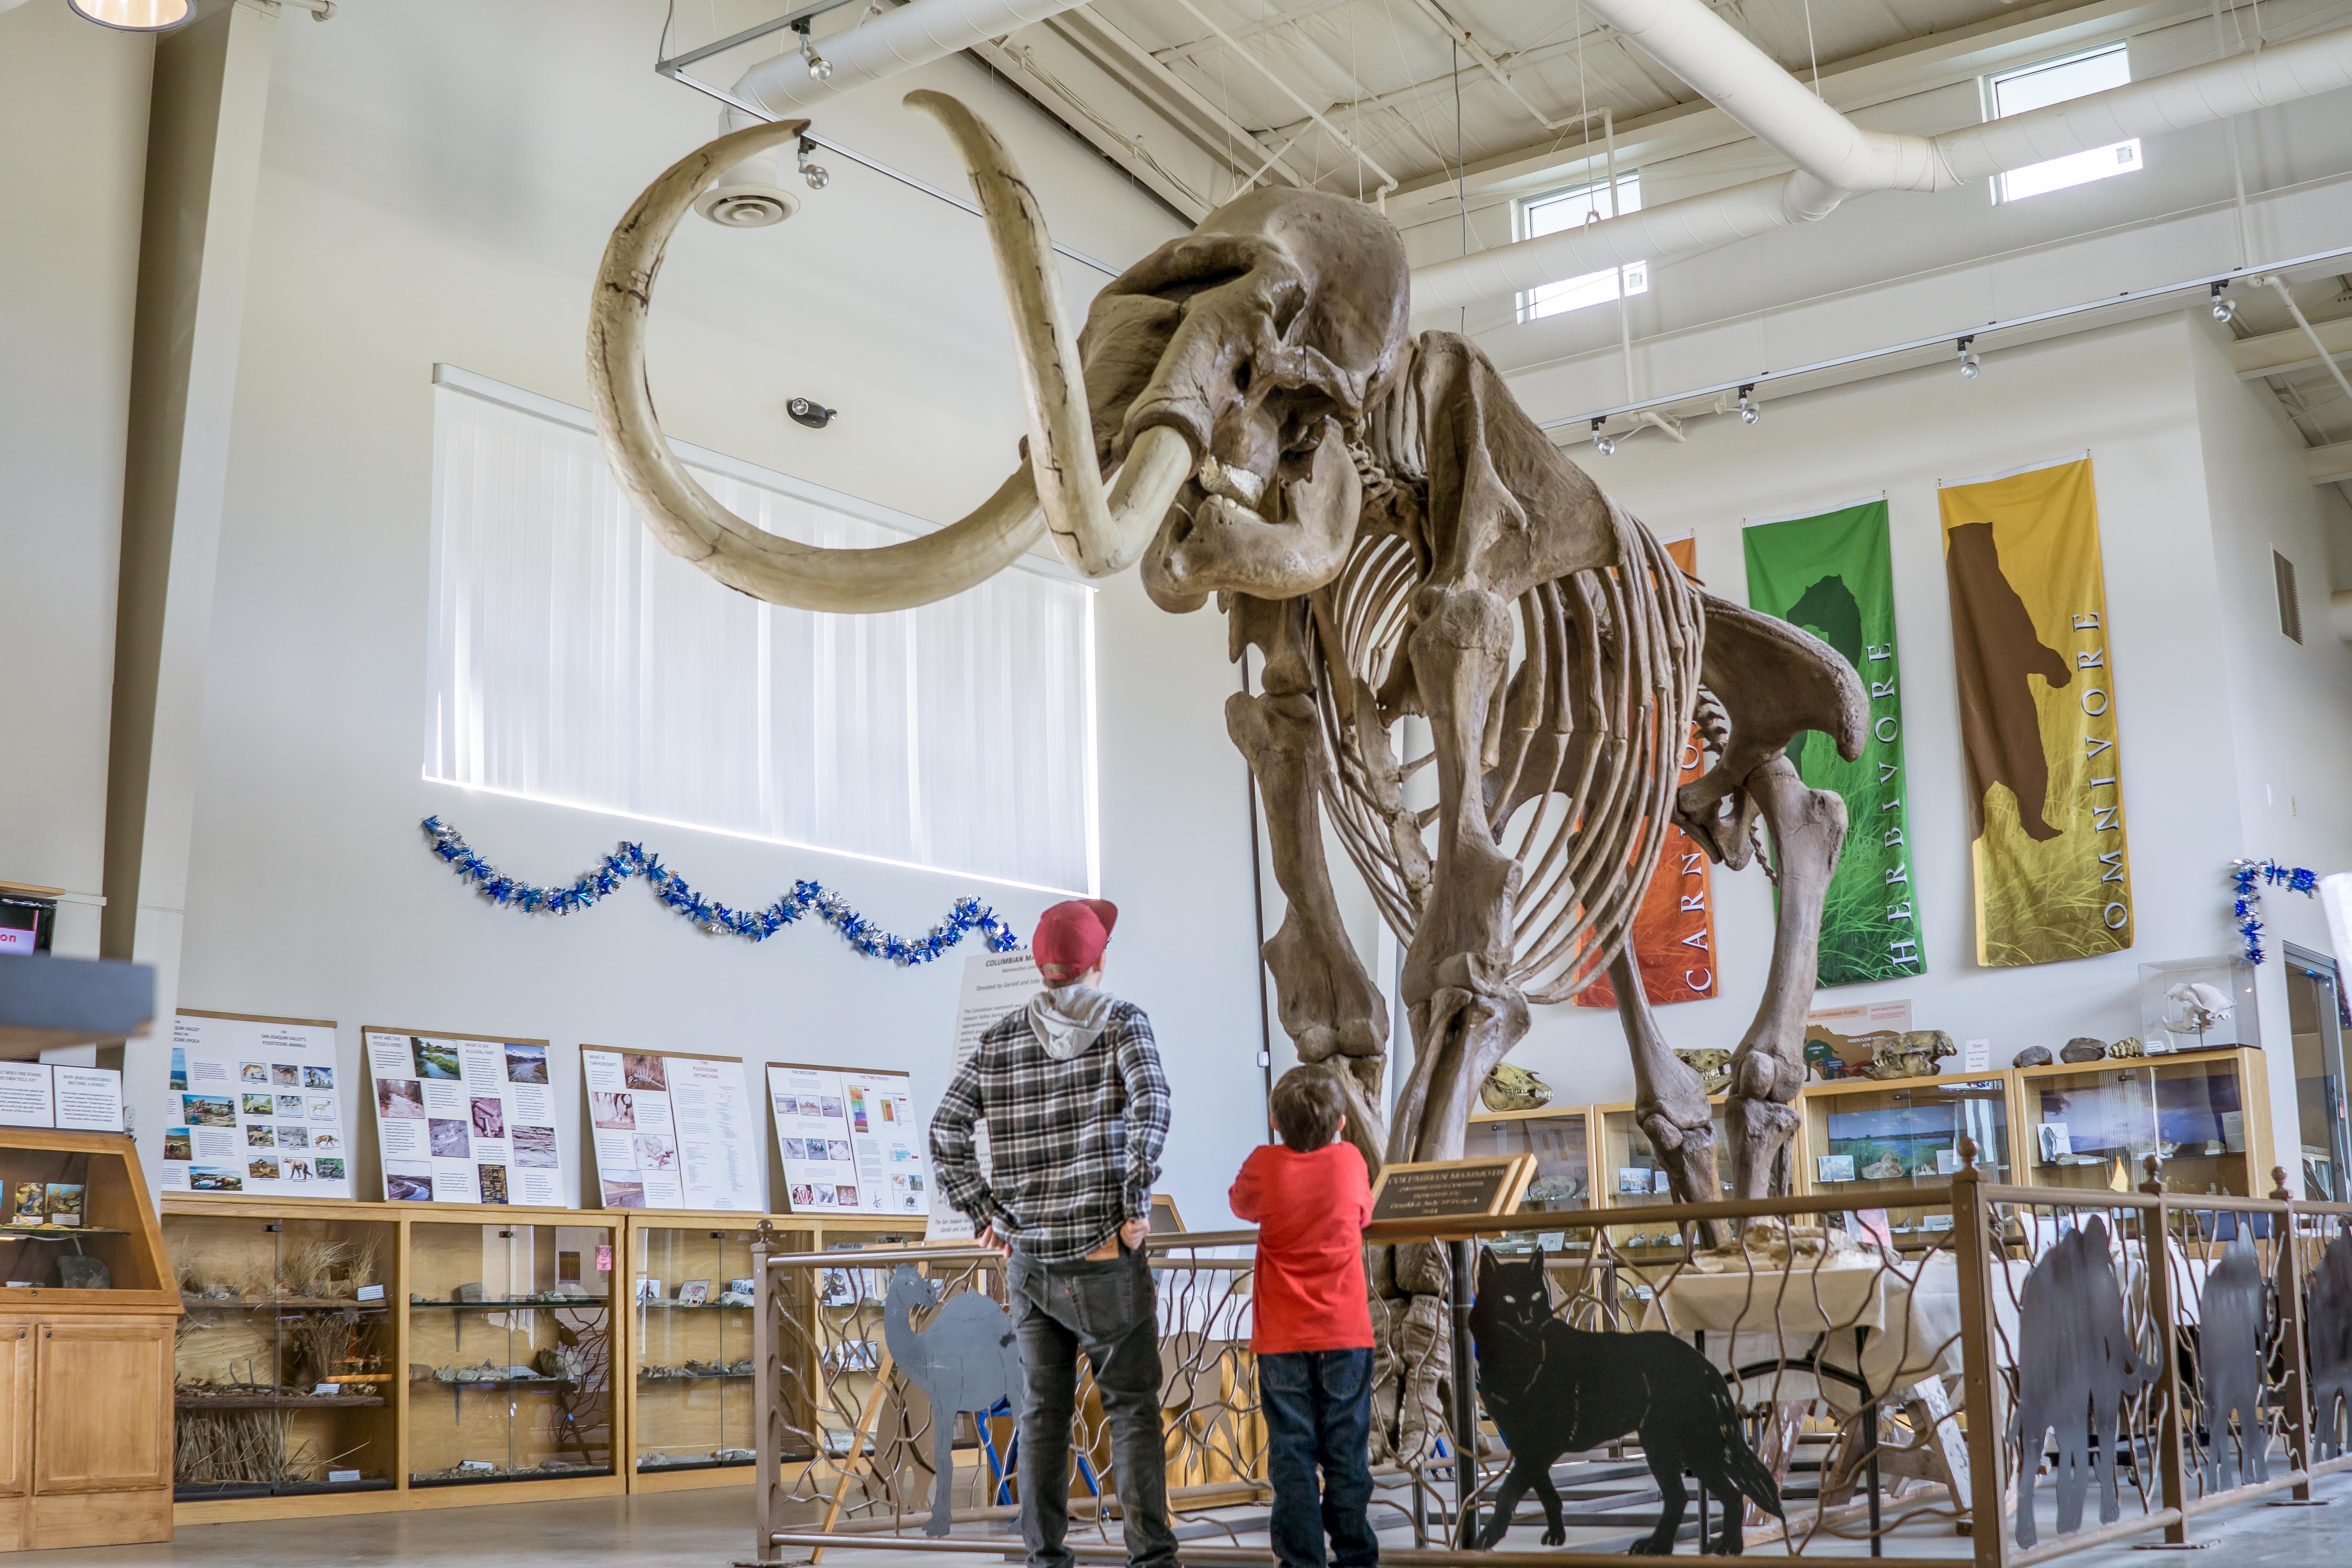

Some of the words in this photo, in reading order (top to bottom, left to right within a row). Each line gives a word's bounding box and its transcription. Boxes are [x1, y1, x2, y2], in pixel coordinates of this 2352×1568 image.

[1679, 720, 1712, 992] CARNO
[1867, 642, 1920, 967] HERBIVORE
[2072, 611, 2128, 930] OMNIVORE
[0, 934, 16, 942] on
[985, 956, 1024, 967] COLUMBIAN
